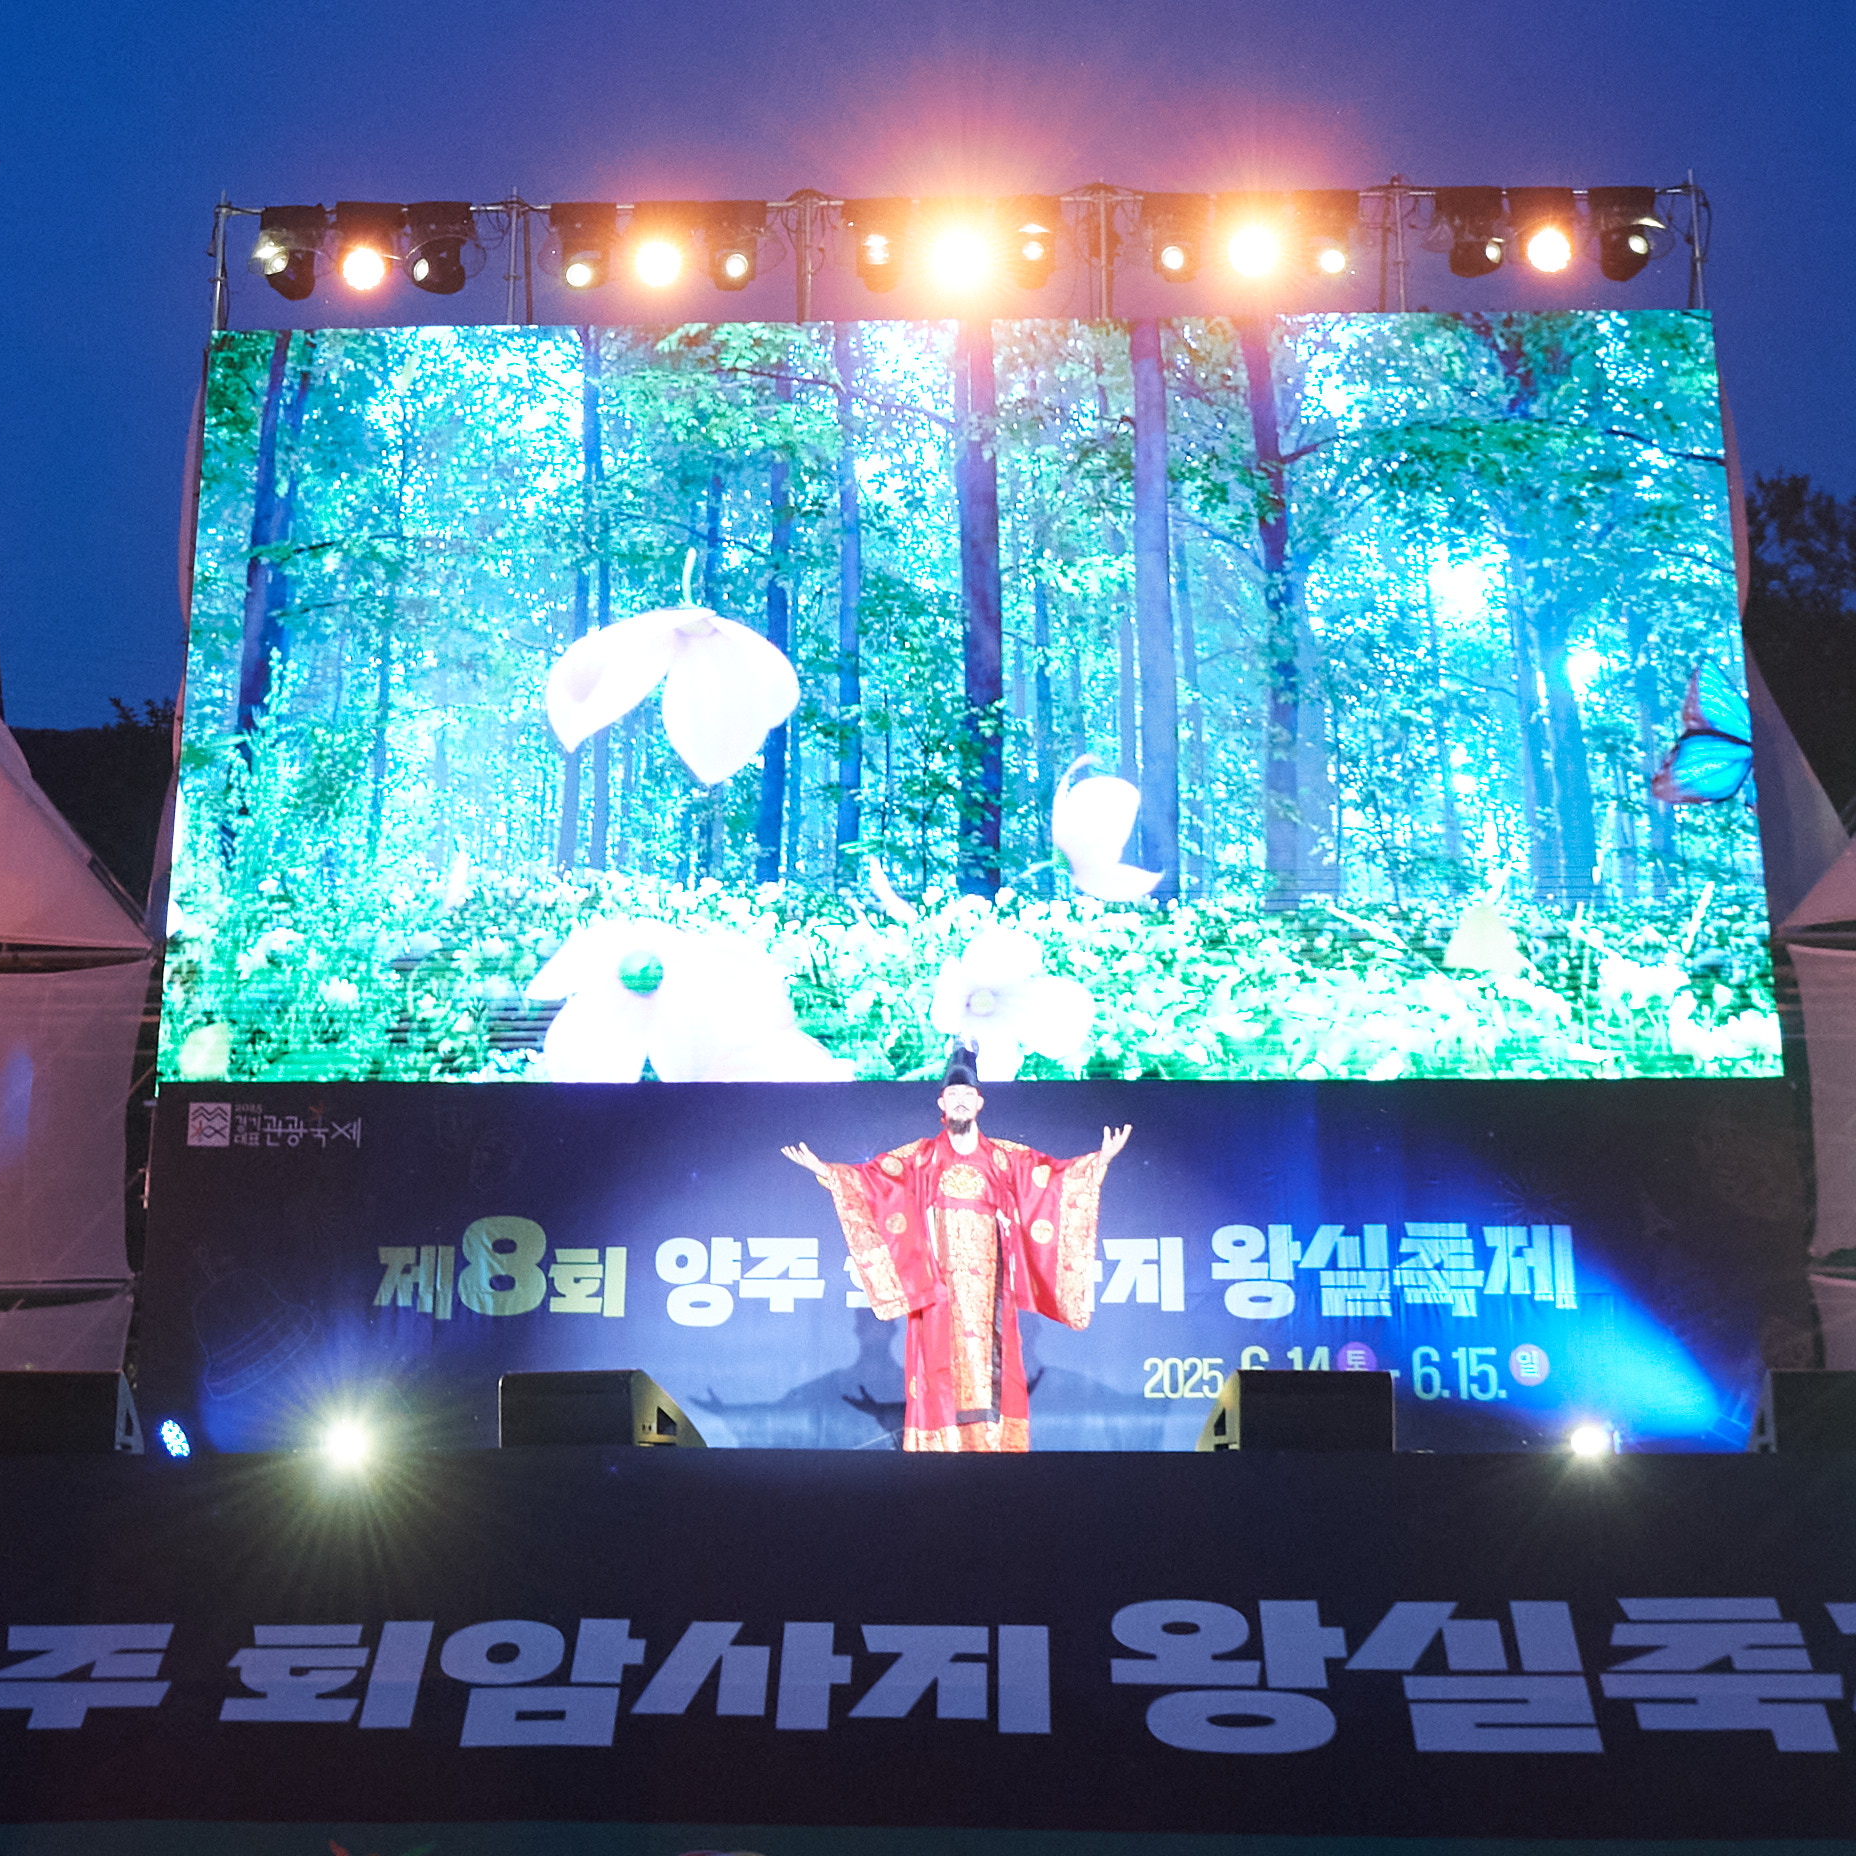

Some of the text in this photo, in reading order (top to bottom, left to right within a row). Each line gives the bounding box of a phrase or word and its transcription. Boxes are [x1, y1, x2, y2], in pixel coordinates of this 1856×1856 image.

[372, 1215, 627, 1320] 제8회
[655, 1236, 826, 1327] 양주
[1210, 1221, 1578, 1319] 왕실축제
[218, 1618, 1052, 1748] 회암사지
